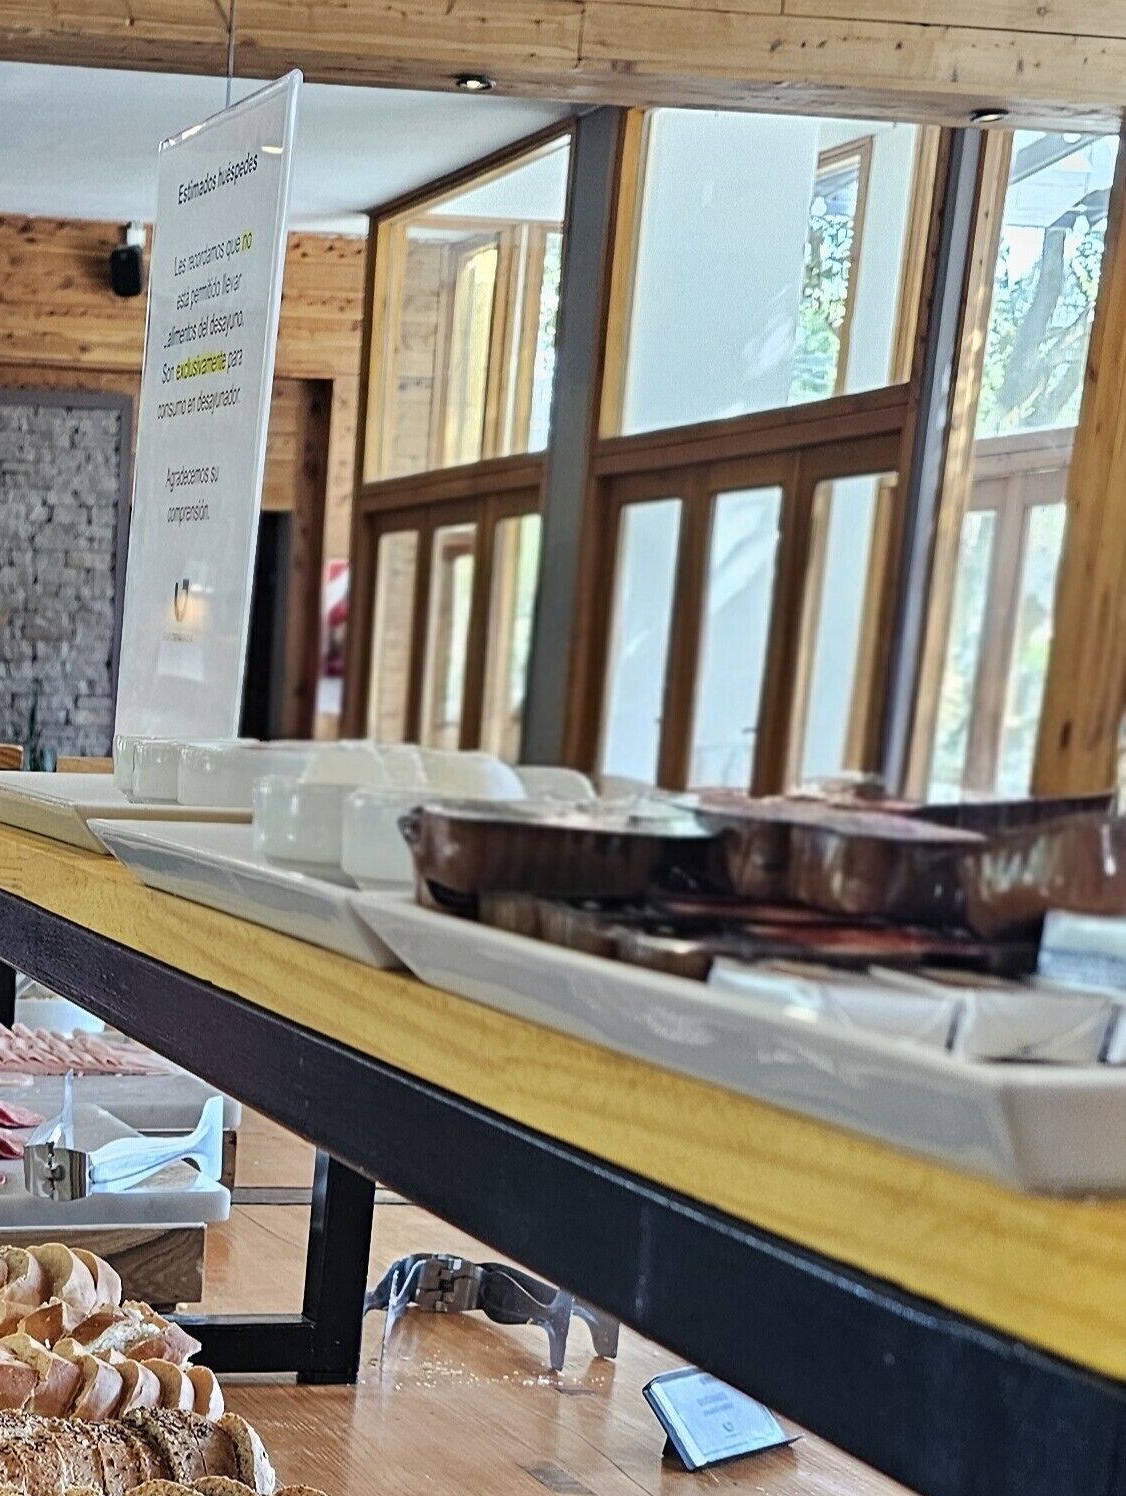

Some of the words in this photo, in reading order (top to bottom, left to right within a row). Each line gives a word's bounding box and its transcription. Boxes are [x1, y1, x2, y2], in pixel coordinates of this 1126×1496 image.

[177, 172, 217, 205] Estimados
[217, 152, 258, 186] huéspedes
[174, 256, 187, 277] Les
[188, 242, 225, 271] recordamos
[225, 236, 241, 261] que
[241, 232, 253, 251] no
[189, 276, 221, 311] permitido
[221, 273, 243, 296] llevar
[197, 315, 210, 339] del
[161, 362, 176, 384] Son
[175, 352, 227, 381] exclusivamente
[226, 348, 244, 374] para
[156, 398, 187, 420] consumo
[186, 396, 196, 414] en
[166, 465, 210, 493] Agradecemos
[210, 465, 220, 482] su
